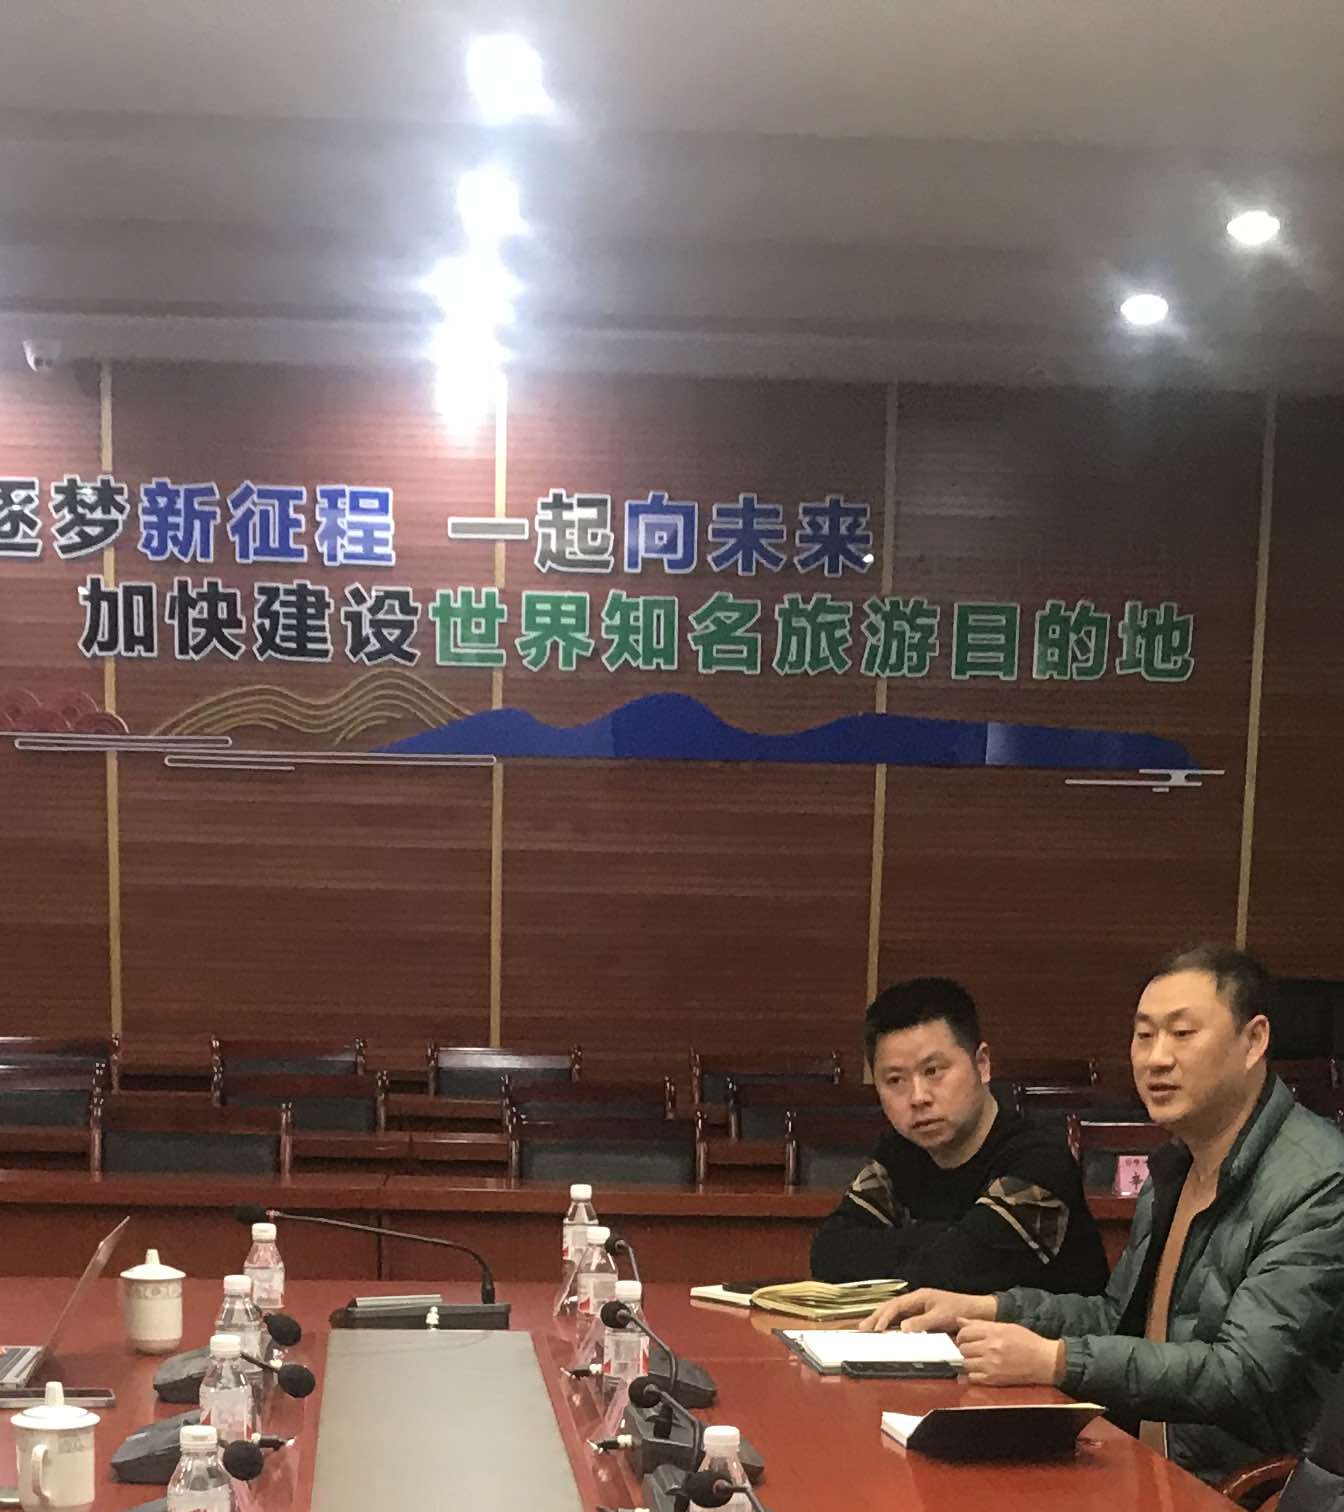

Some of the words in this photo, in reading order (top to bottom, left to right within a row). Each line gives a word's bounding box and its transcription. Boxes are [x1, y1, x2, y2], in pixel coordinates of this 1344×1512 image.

[446, 487, 875, 576] 一起向未来
[77, 575, 1196, 683] 加快建设世界知名旅游目的地
